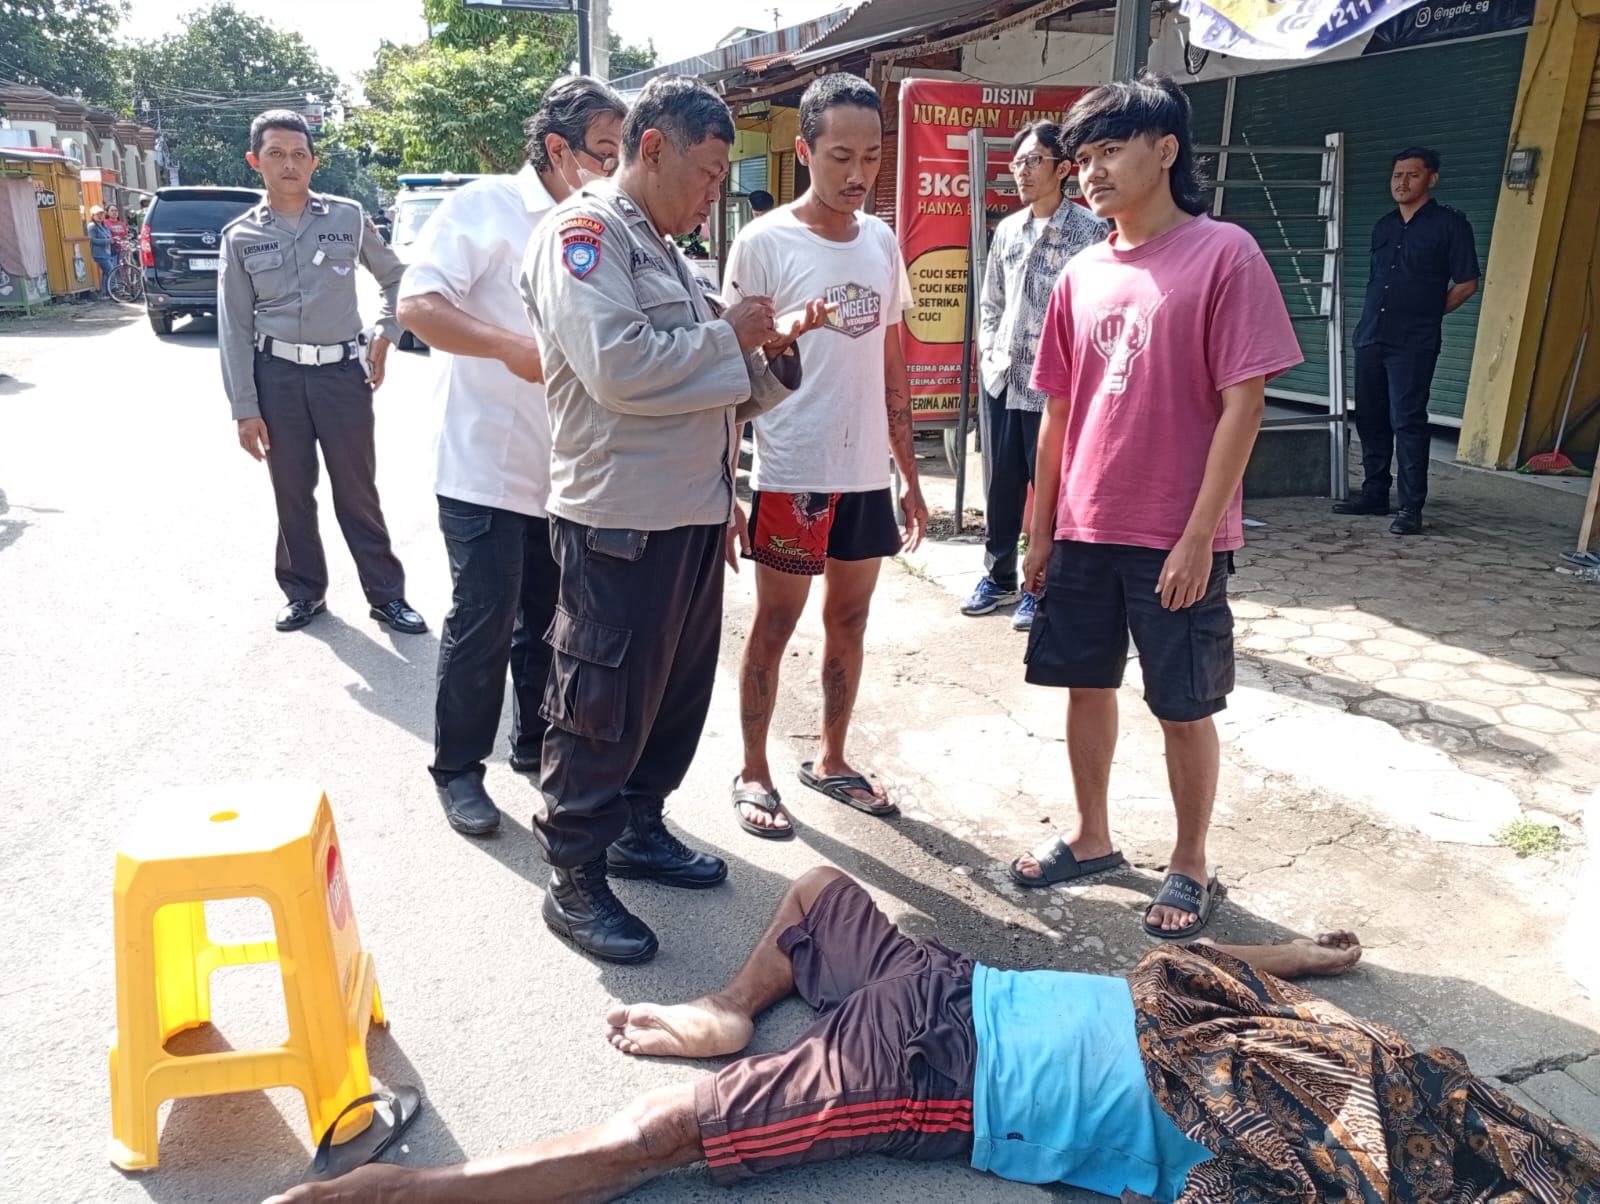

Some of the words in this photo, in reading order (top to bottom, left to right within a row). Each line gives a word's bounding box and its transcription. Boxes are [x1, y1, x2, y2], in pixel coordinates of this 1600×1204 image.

[982, 87, 1035, 106] DISINI
[913, 104, 1001, 129] JURAGAN
[917, 172, 970, 198] 3KG
[918, 202, 964, 215] HANYA
[318, 233, 353, 242] POLRI
[244, 242, 279, 256] KRISNAWAN
[919, 269, 943, 278] CUCI
[826, 286, 848, 304] LOS
[919, 284, 942, 293] CUCI
[918, 298, 960, 307] SETRIKA
[835, 296, 879, 328] ANGELES
[918, 312, 941, 321] CUCI
